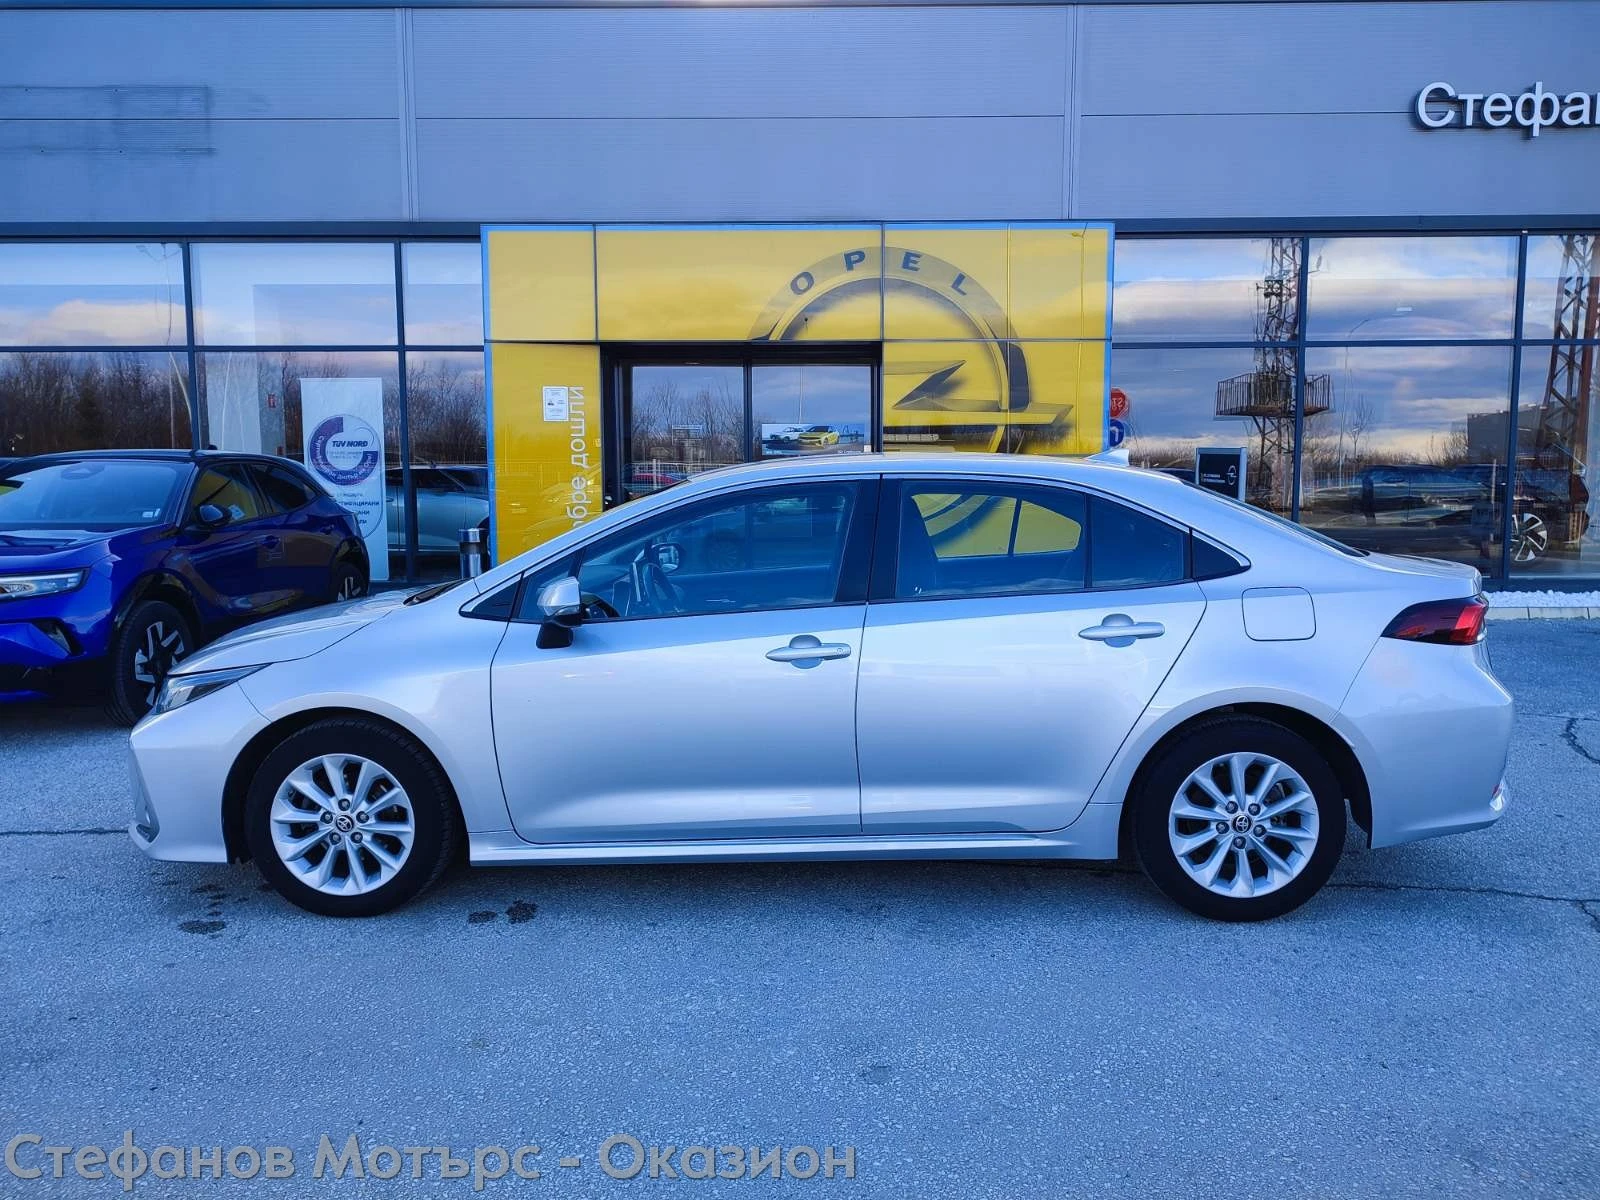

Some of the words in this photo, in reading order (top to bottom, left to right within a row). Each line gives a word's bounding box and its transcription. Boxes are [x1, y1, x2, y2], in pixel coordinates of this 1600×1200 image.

[1416, 81, 1600, 137] Стефа
[790, 250, 968, 296] OPEL
[346, 440, 368, 448] NORD
[568, 386, 592, 470] дошли
[566, 476, 592, 529] бре
